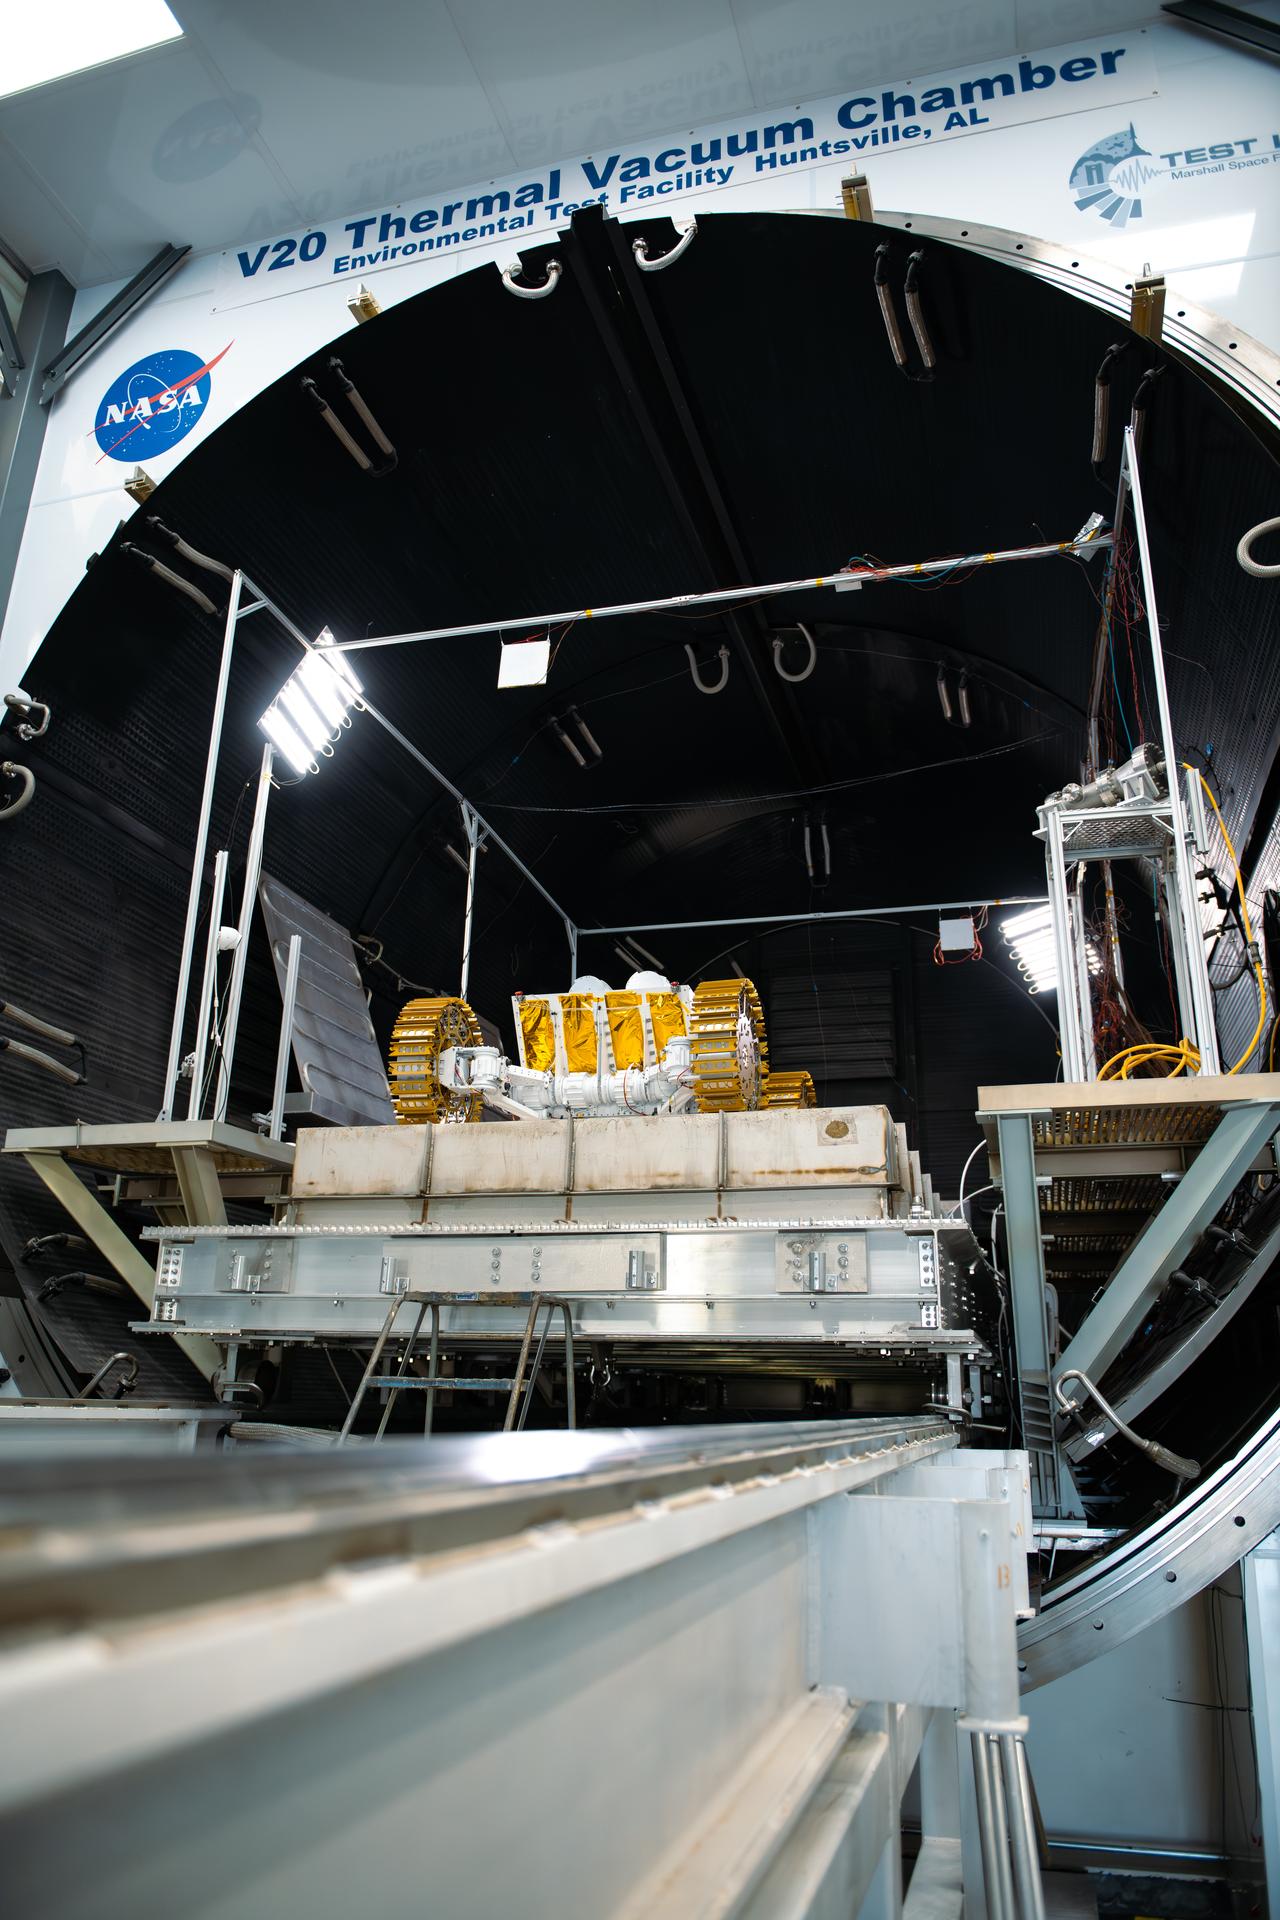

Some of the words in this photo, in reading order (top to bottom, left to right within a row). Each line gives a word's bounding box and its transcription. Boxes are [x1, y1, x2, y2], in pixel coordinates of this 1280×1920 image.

[237, 231, 327, 277] V20
[345, 169, 560, 249] Thermal
[580, 118, 813, 189] Vacuum
[837, 48, 1127, 129] Chamber
[1160, 138, 1257, 167] TEST
[1171, 163, 1225, 180] Marshall
[1228, 156, 1270, 170] Space
[334, 210, 533, 273] Environmental
[620, 166, 734, 203] Facility
[755, 125, 931, 172] Huntsville,
[944, 108, 989, 131] AL
[103, 385, 203, 427] NASA
